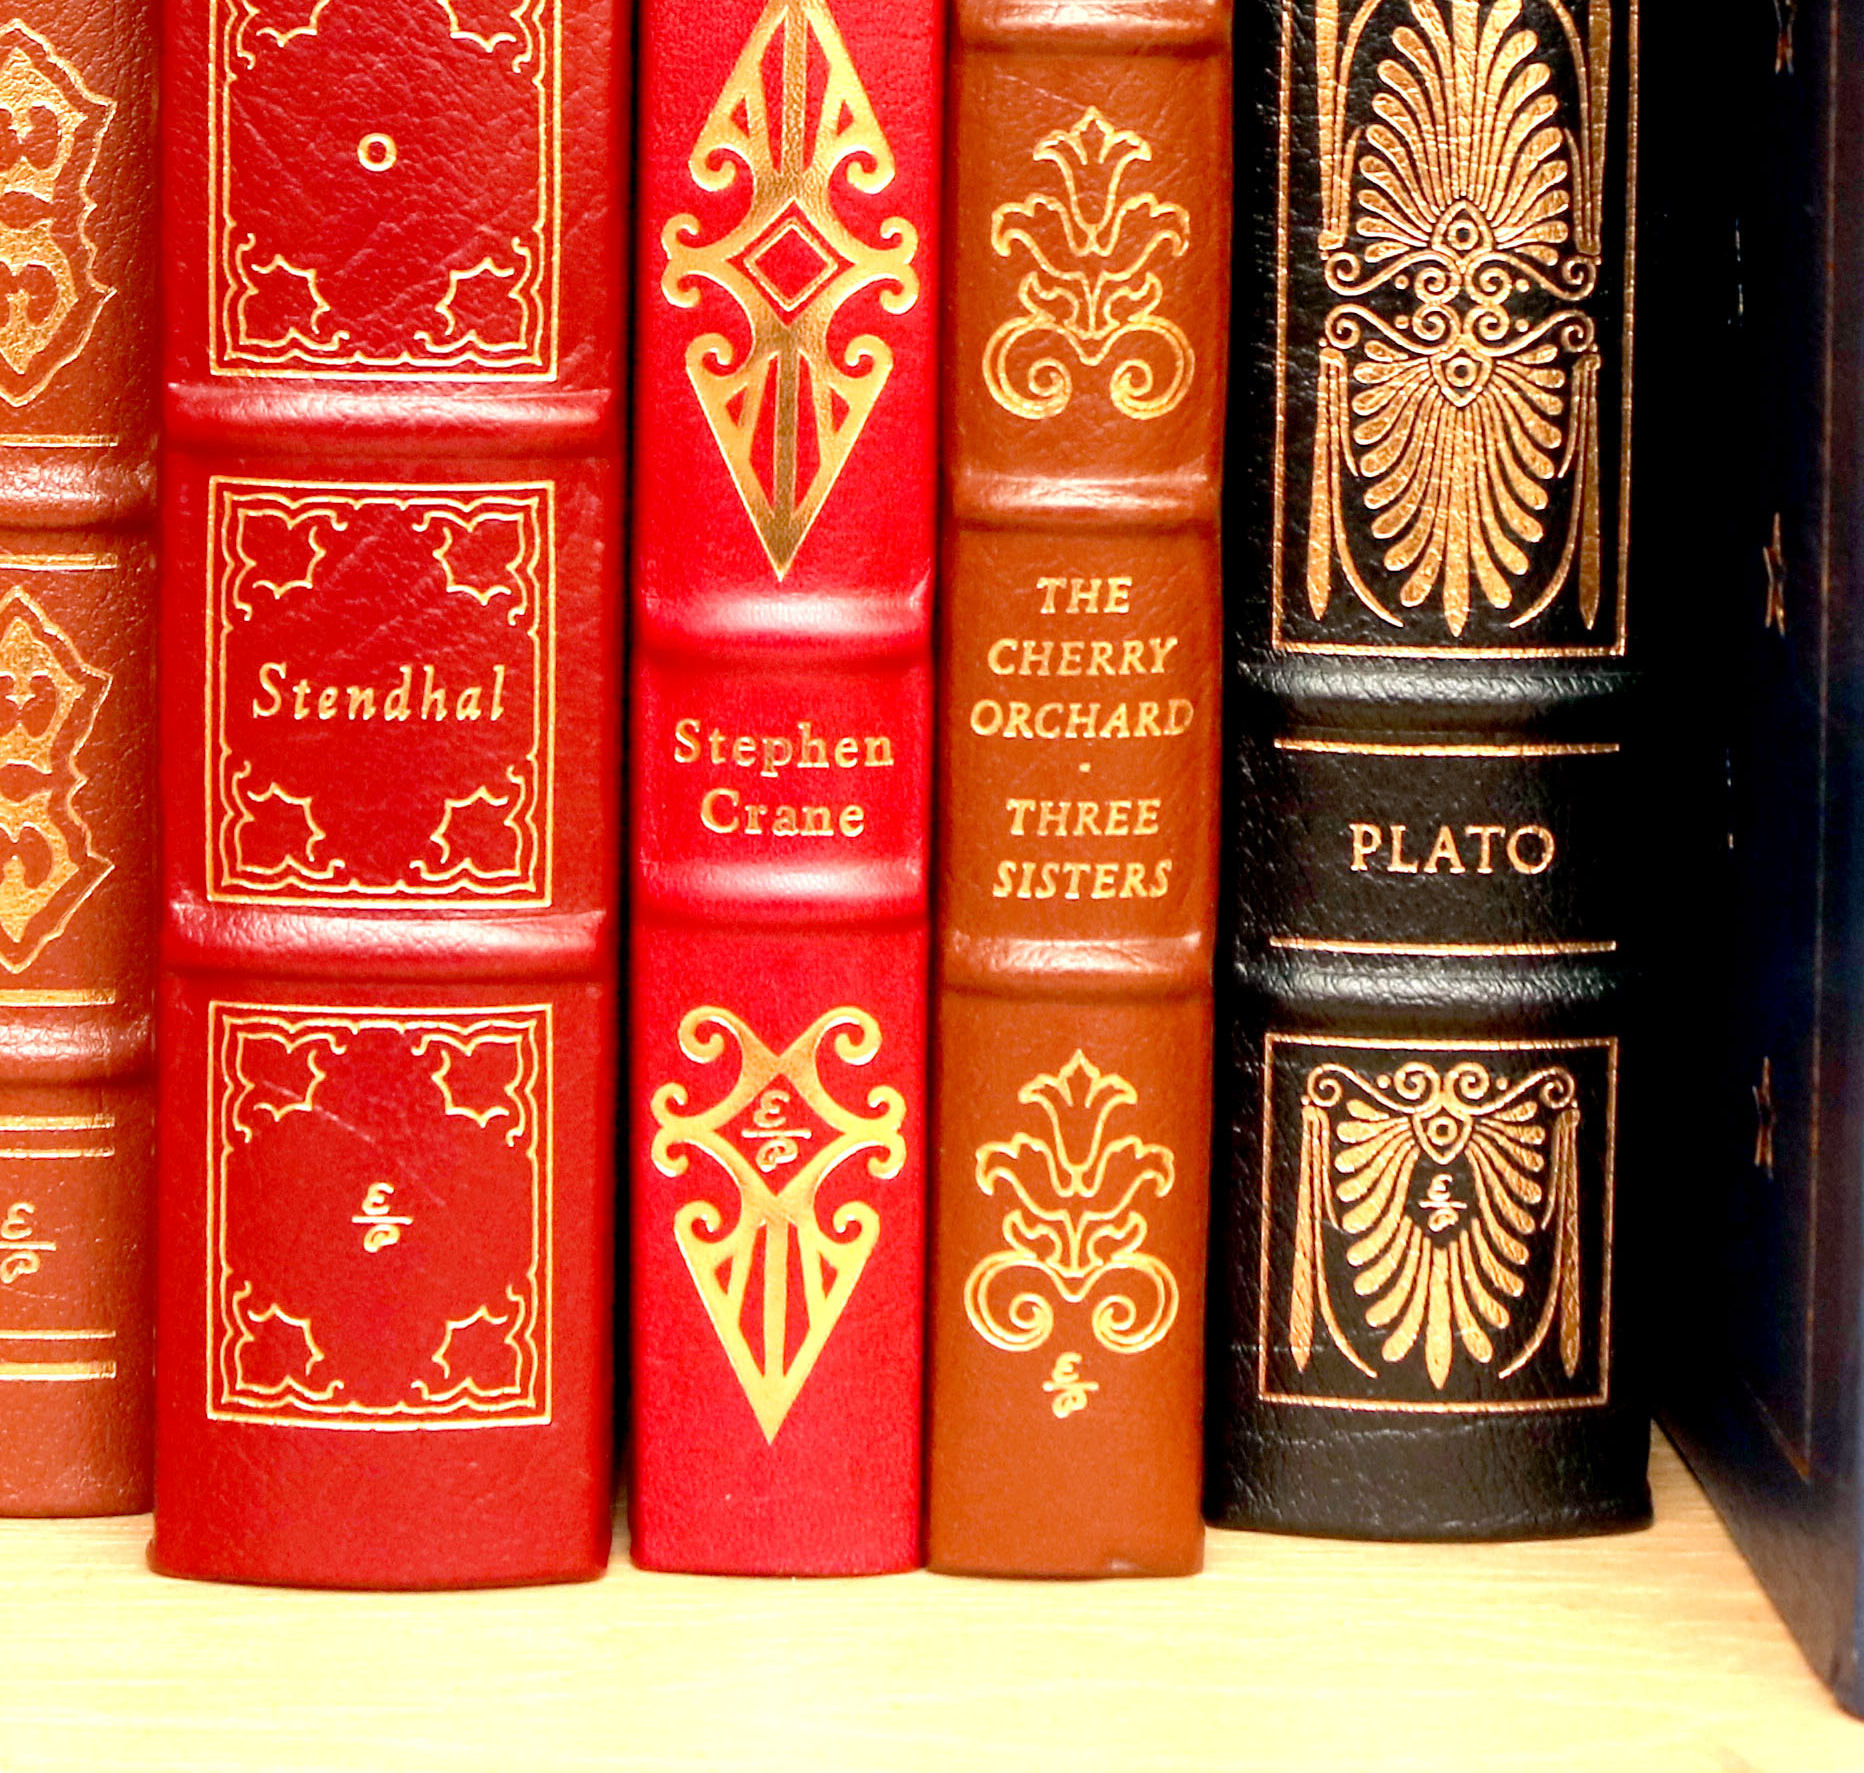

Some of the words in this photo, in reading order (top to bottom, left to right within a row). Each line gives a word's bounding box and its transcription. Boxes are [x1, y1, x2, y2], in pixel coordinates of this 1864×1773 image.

[1036, 577, 1132, 614] THE
[987, 636, 1178, 676] CHERRY
[252, 663, 507, 723] Stendhal
[970, 699, 1195, 739] ORCHARD
[673, 719, 895, 773] Stephen
[700, 789, 865, 839] Crane
[1006, 798, 1161, 836] THREE
[1348, 823, 1555, 874] PLATO
[992, 859, 1173, 900] SISTERS
